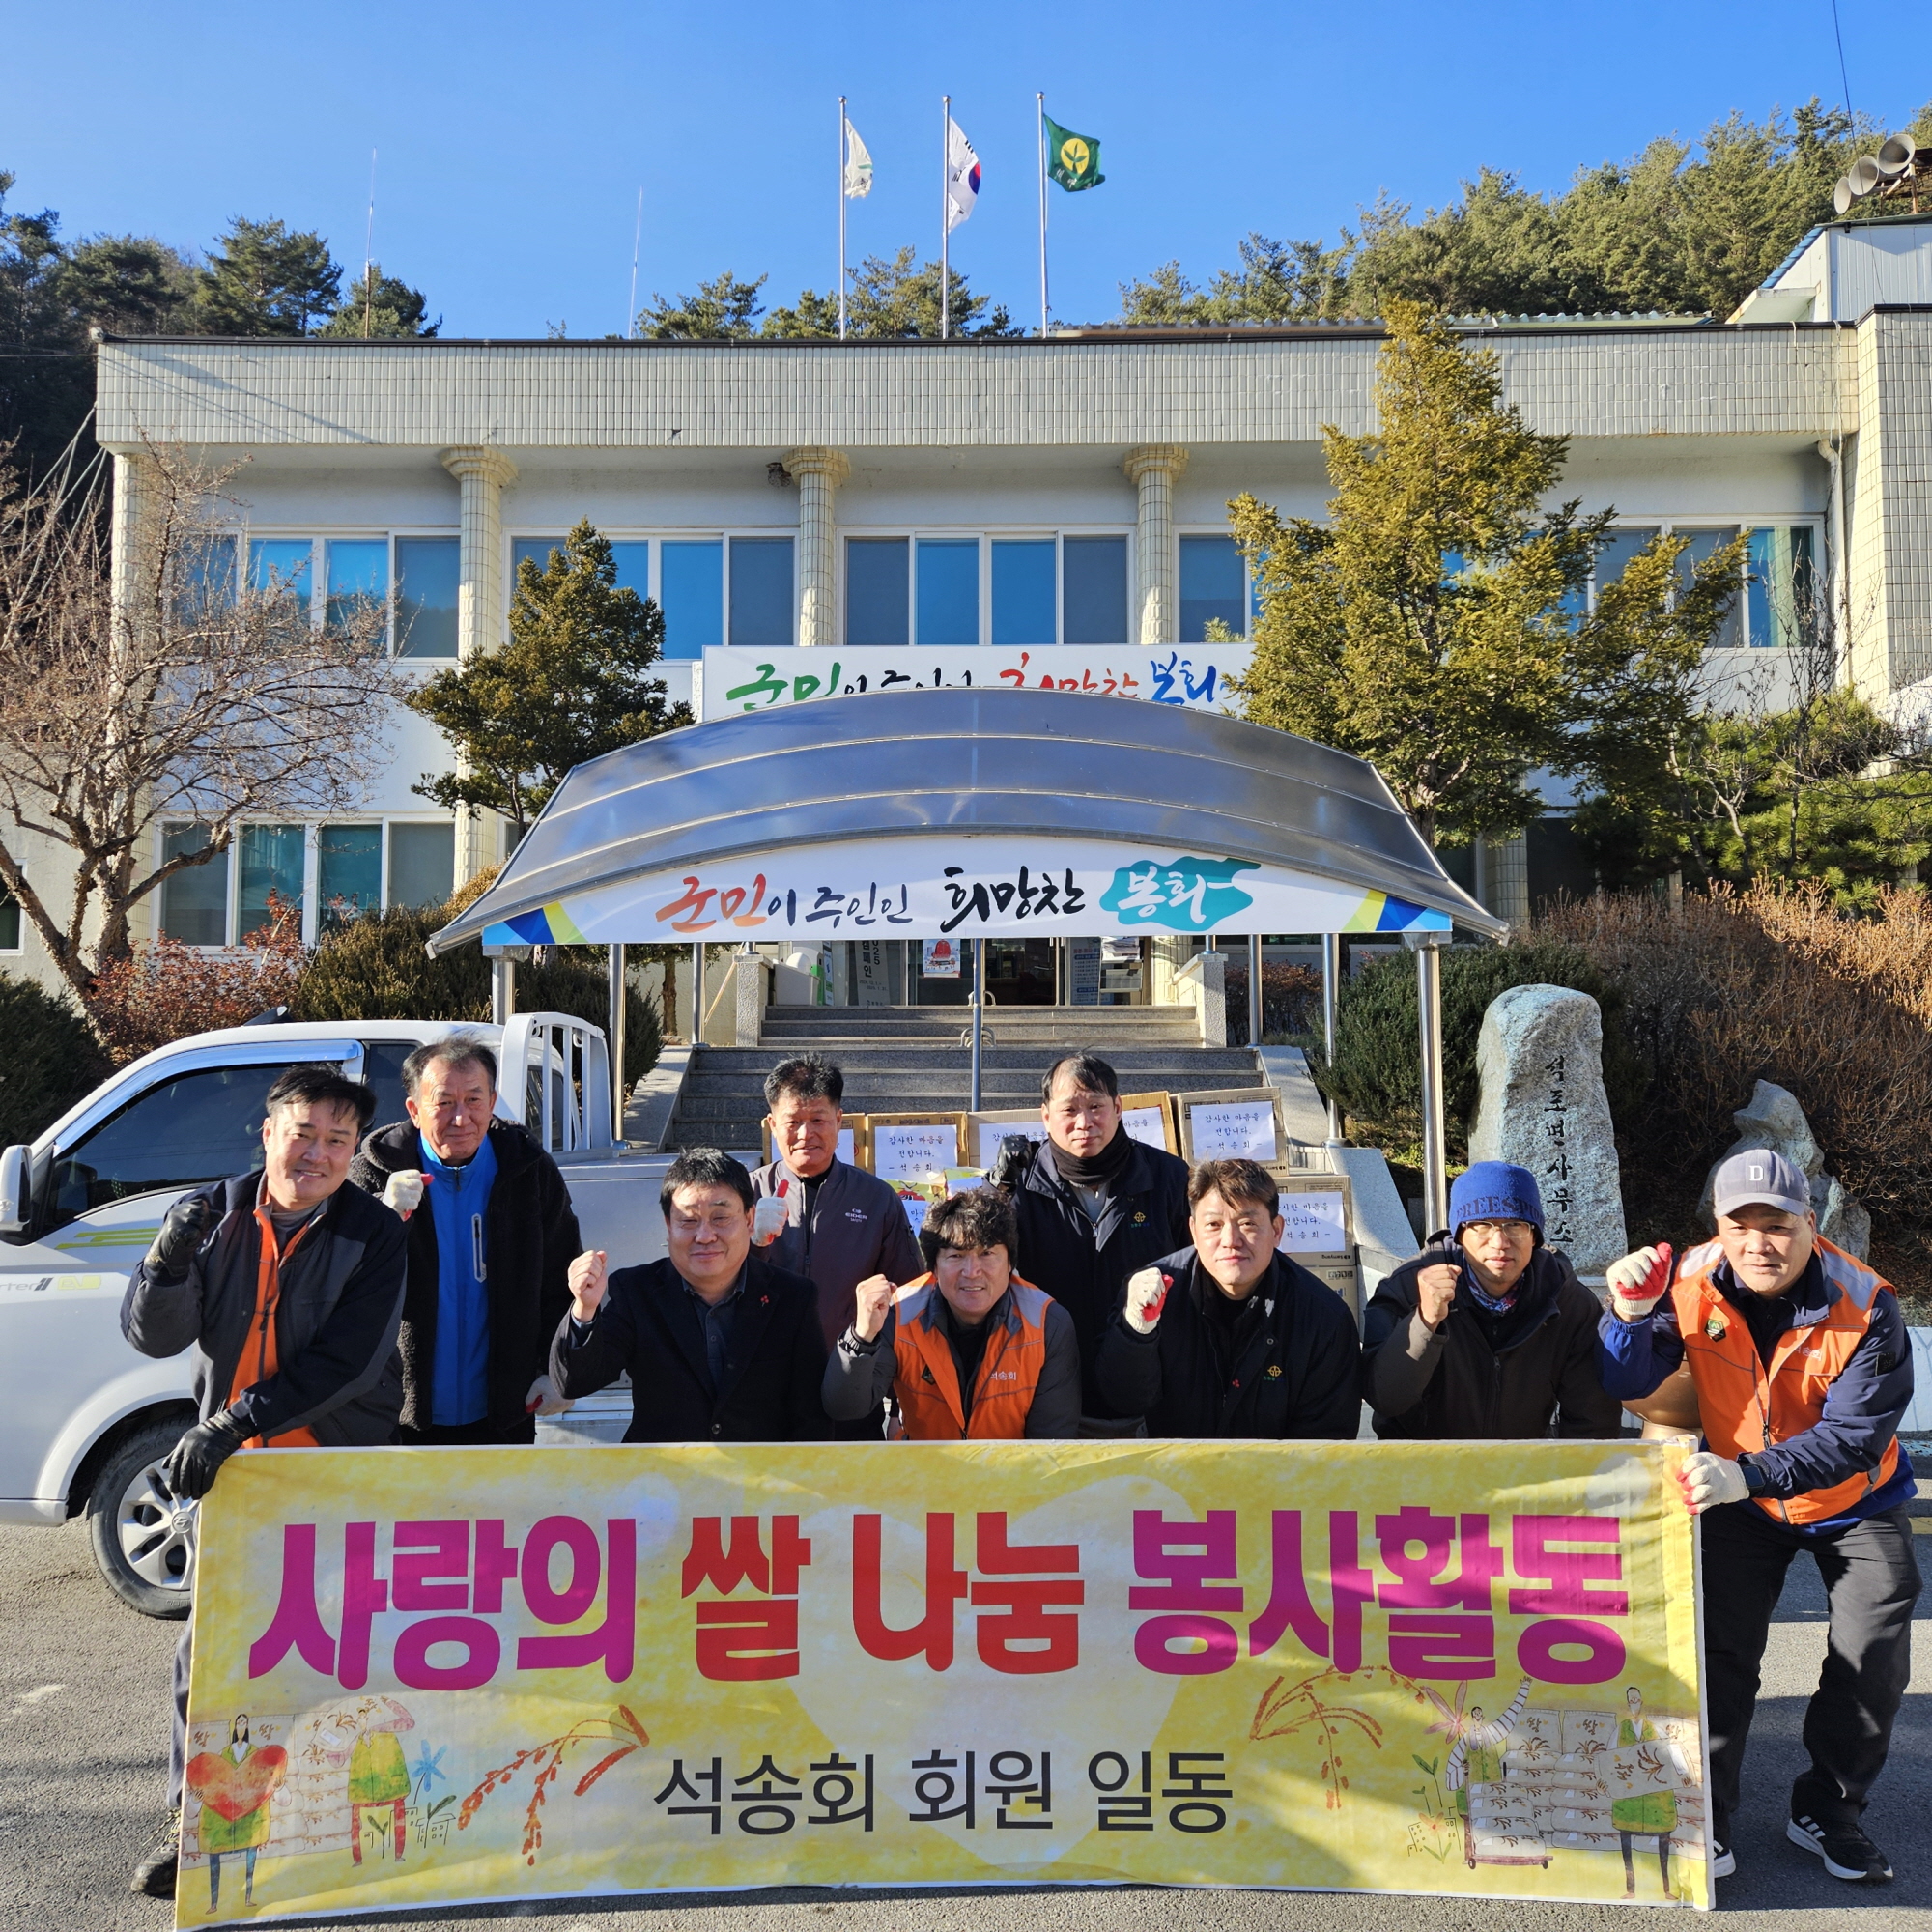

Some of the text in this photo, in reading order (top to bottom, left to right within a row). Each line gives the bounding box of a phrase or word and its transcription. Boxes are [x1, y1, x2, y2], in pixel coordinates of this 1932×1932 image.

[655, 866, 1208, 933] 군민이 주인인 희망찬 봉화
[1205, 1111, 1260, 1123] 감사한 마음을
[1215, 1126, 1252, 1137] 전합니다.
[889, 1134, 944, 1146] 감사한 마음을
[898, 1149, 935, 1158] 전합니다.
[1748, 1165, 1765, 1181] D
[1277, 1201, 1329, 1212] 사한 마음을
[249, 1506, 1628, 1690] 사랑의 쌀 나눔 봉사활동
[654, 1749, 1233, 1835] 석송회 회원 일동
